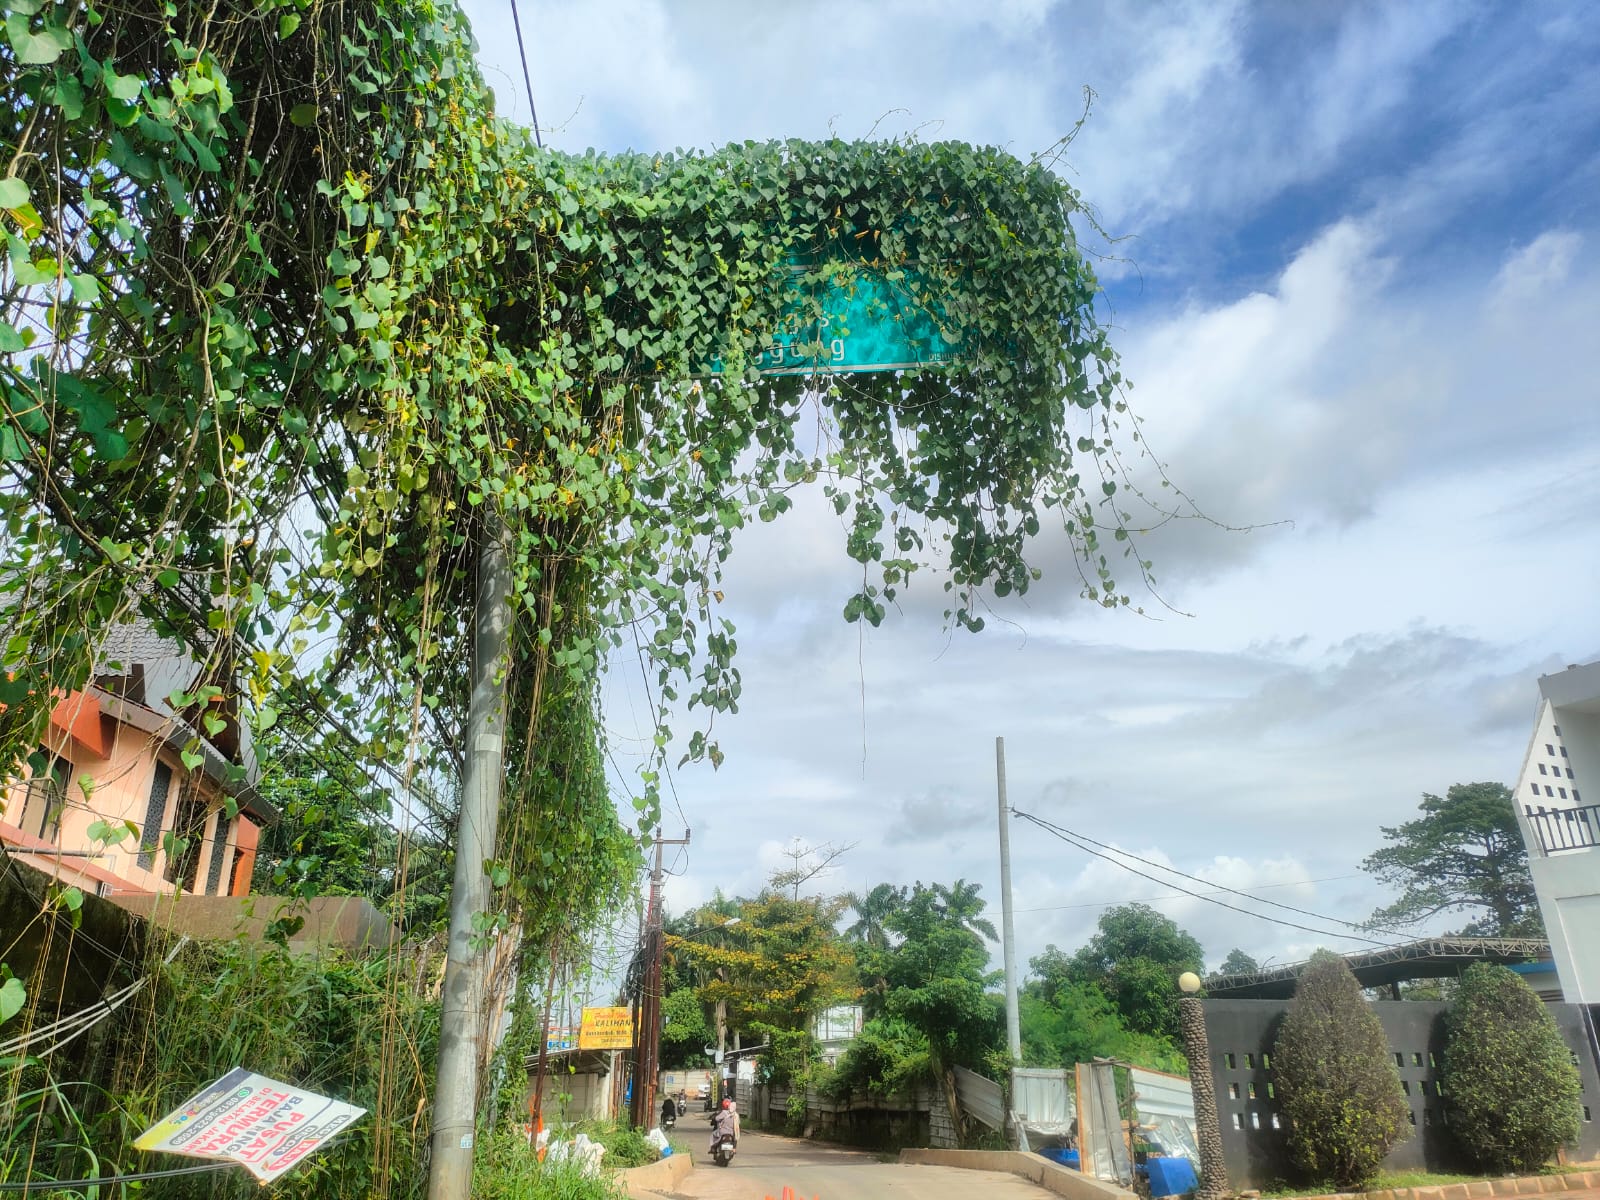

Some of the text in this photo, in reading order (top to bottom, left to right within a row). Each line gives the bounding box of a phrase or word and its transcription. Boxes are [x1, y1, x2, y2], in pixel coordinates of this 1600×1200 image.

[259, 1087, 272, 1096] DI
[218, 1096, 261, 1126] SELATAN
[262, 1096, 303, 1123] BAJA
[240, 1112, 305, 1159] PUSAT
